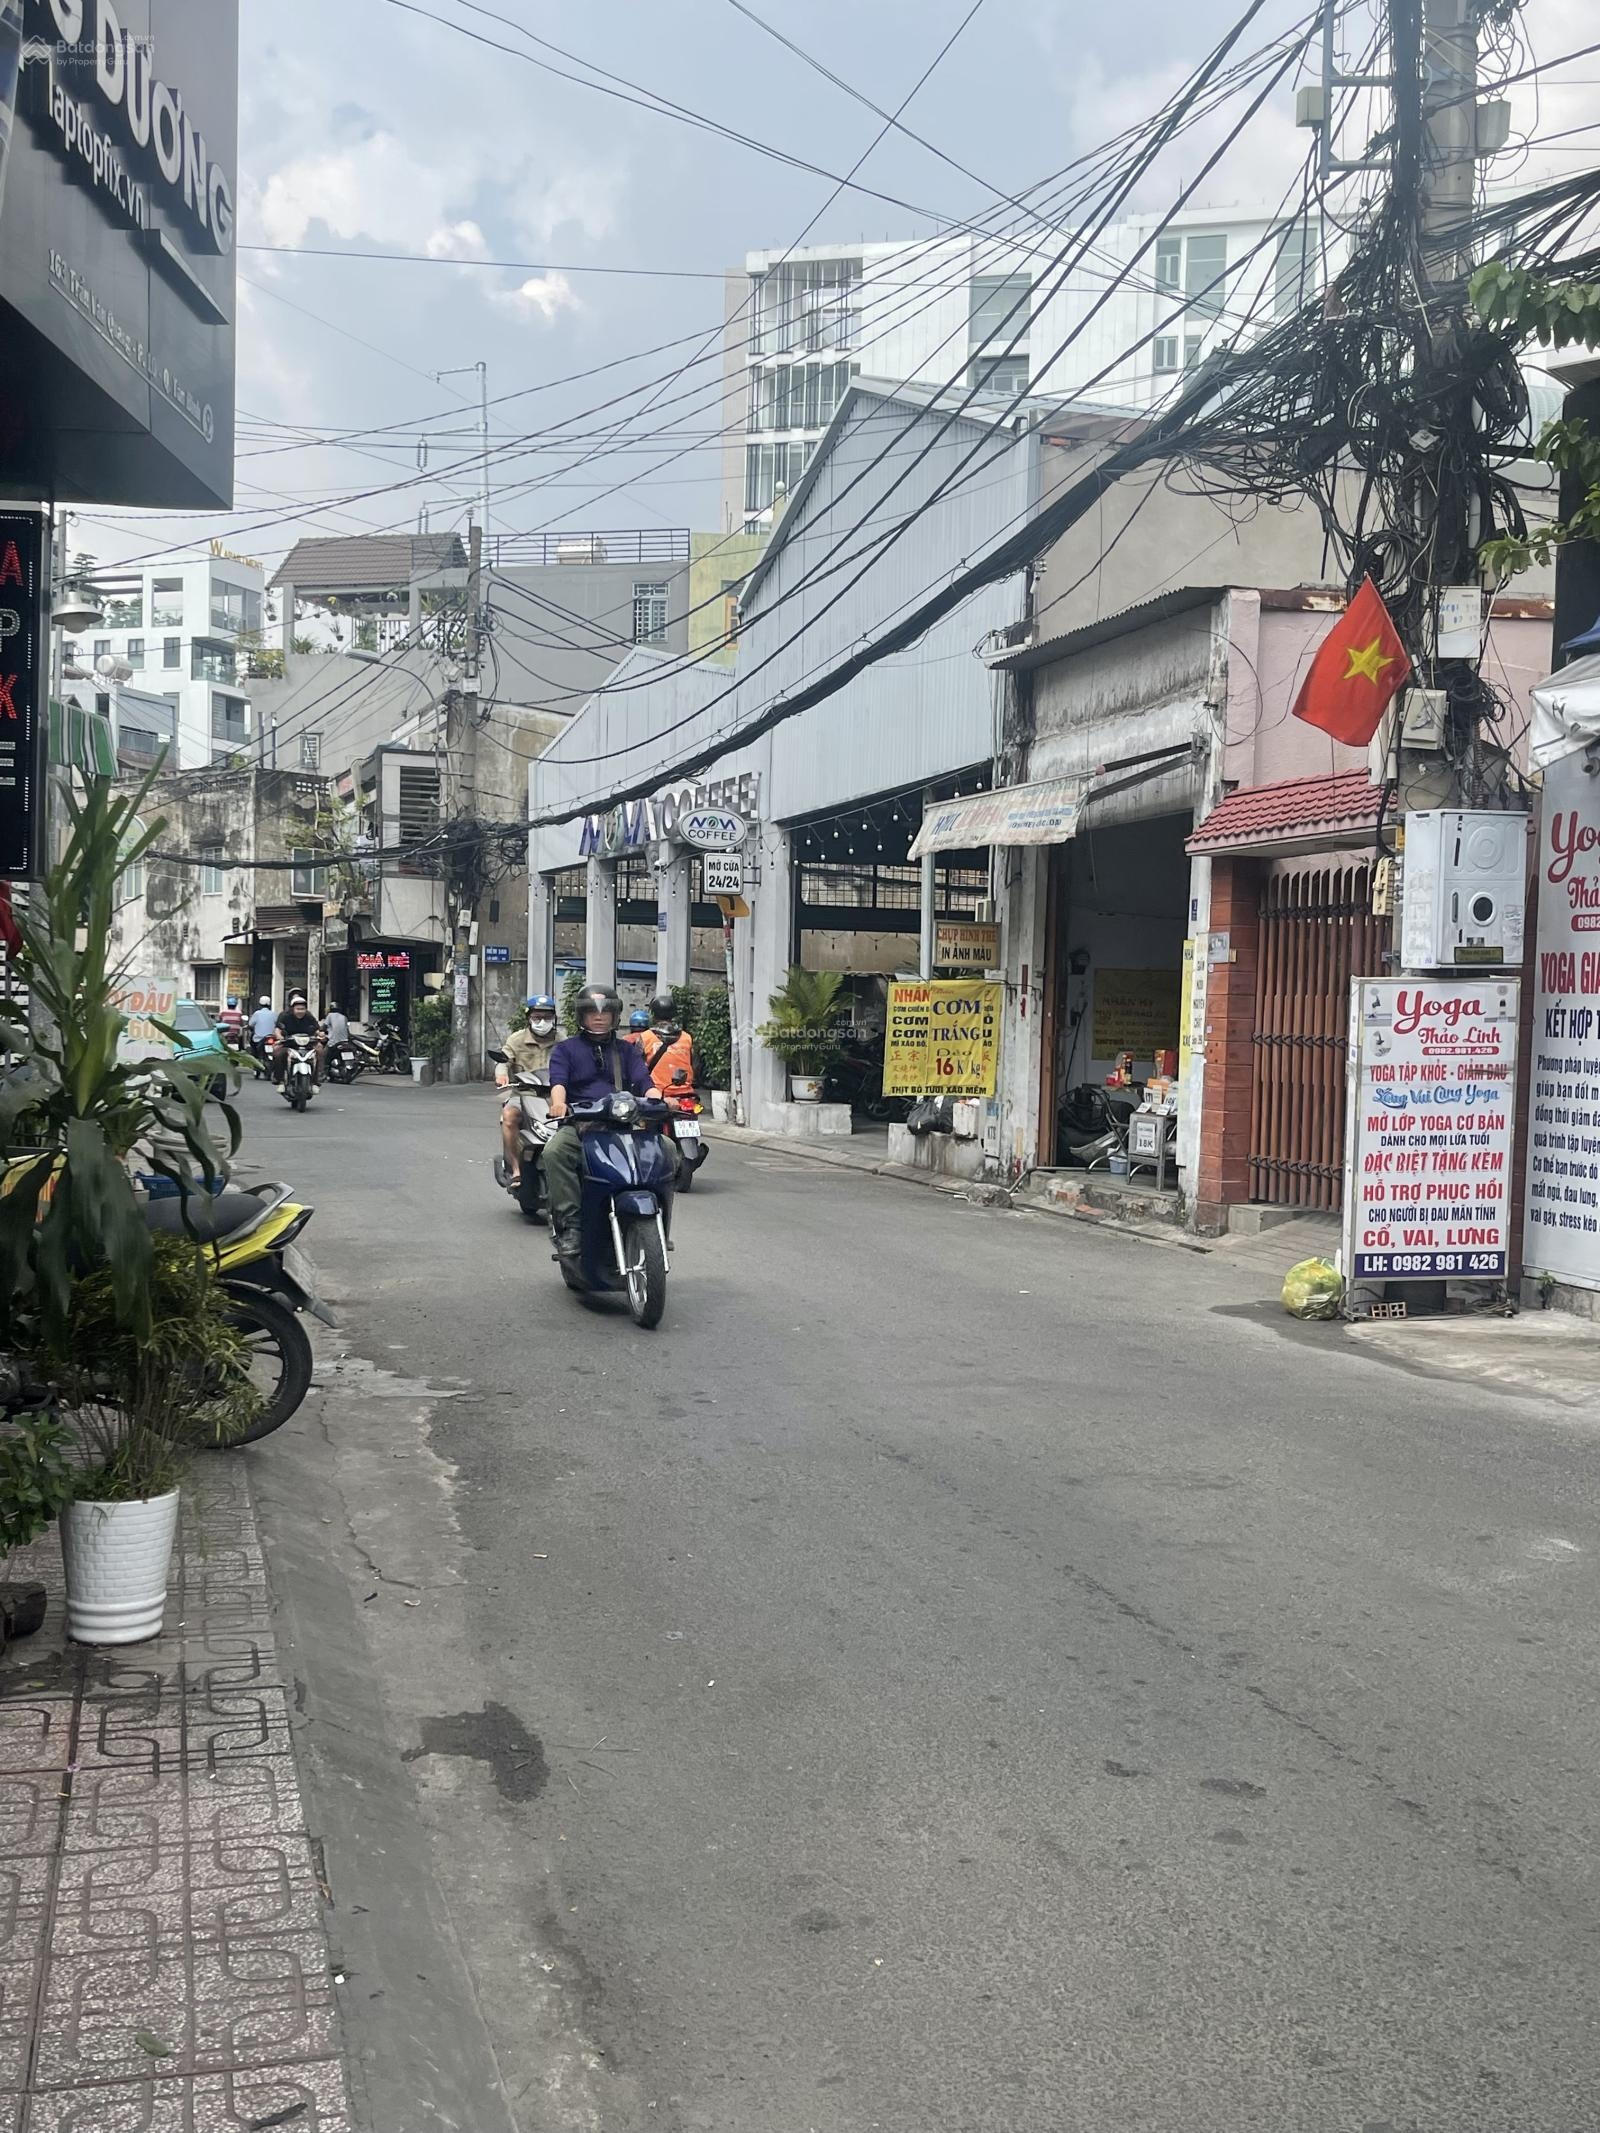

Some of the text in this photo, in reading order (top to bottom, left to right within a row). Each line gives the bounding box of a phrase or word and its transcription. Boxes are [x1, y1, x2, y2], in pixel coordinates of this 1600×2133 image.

[49, 59, 145, 231] laptopfix.vn
[688, 829, 737, 841] COFFEE
[708, 875, 740, 888] 24/24
[942, 946, 950, 959] IN
[1541, 952, 1576, 994] YOGA
[932, 999, 981, 1015] CƠM
[1393, 990, 1486, 1034] Yoga
[892, 1016, 928, 1025] CƠM
[932, 1021, 980, 1041] TRẮNG
[1545, 999, 1592, 1046] KẾT HỢP
[892, 1029, 928, 1038] CƠM
[1418, 1026, 1503, 1044] Thảo Linh
[935, 1057, 954, 1075] 16
[1370, 1065, 1395, 1082] YOGA
[1399, 1061, 1417, 1085] TẬP
[1421, 1059, 1447, 1081] KHỎE
[1564, 1056, 1581, 1075] pháp
[1465, 1084, 1500, 1105] Yoga
[1536, 1080, 1554, 1099] giúp
[1557, 1081, 1572, 1101] bạn
[1575, 1080, 1588, 1100] đốt
[1368, 1109, 1504, 1132] MỞ LỚP YOGA CƠ BẢN
[1380, 1130, 1490, 1148] DÀNH CHO MỌI LỨA TUỔI
[1567, 1133, 1579, 1154] tập
[1364, 1151, 1392, 1176] ĐẶC
[1396, 1150, 1427, 1176] BIỆT
[1432, 1150, 1468, 1175] TẶNG
[1533, 1155, 1542, 1172] Cơ
[1555, 1158, 1568, 1178] bạn
[1569, 1160, 1587, 1178] trước
[1363, 1178, 1385, 1201] HỖ
[1391, 1182, 1422, 1204] TRỢ
[1426, 1182, 1470, 1203] PHỤC
[1531, 1179, 1545, 1198] mất
[1564, 1185, 1577, 1202] đau
[1580, 1187, 1598, 1208] lưng,
[1368, 1209, 1386, 1222] CHO
[1389, 1204, 1417, 1222] NGƯỜI
[1419, 1207, 1428, 1225] BỊ
[1431, 1207, 1448, 1221] ĐAU
[1475, 1203, 1496, 1221] TÍNH
[1530, 1207, 1541, 1222] vai
[1559, 1211, 1581, 1229] stress
[1583, 1214, 1597, 1232] kéo
[1363, 1223, 1499, 1248] CỔ, VAI, LƯNG
[1364, 1253, 1499, 1272] LH: 0982 981 426
